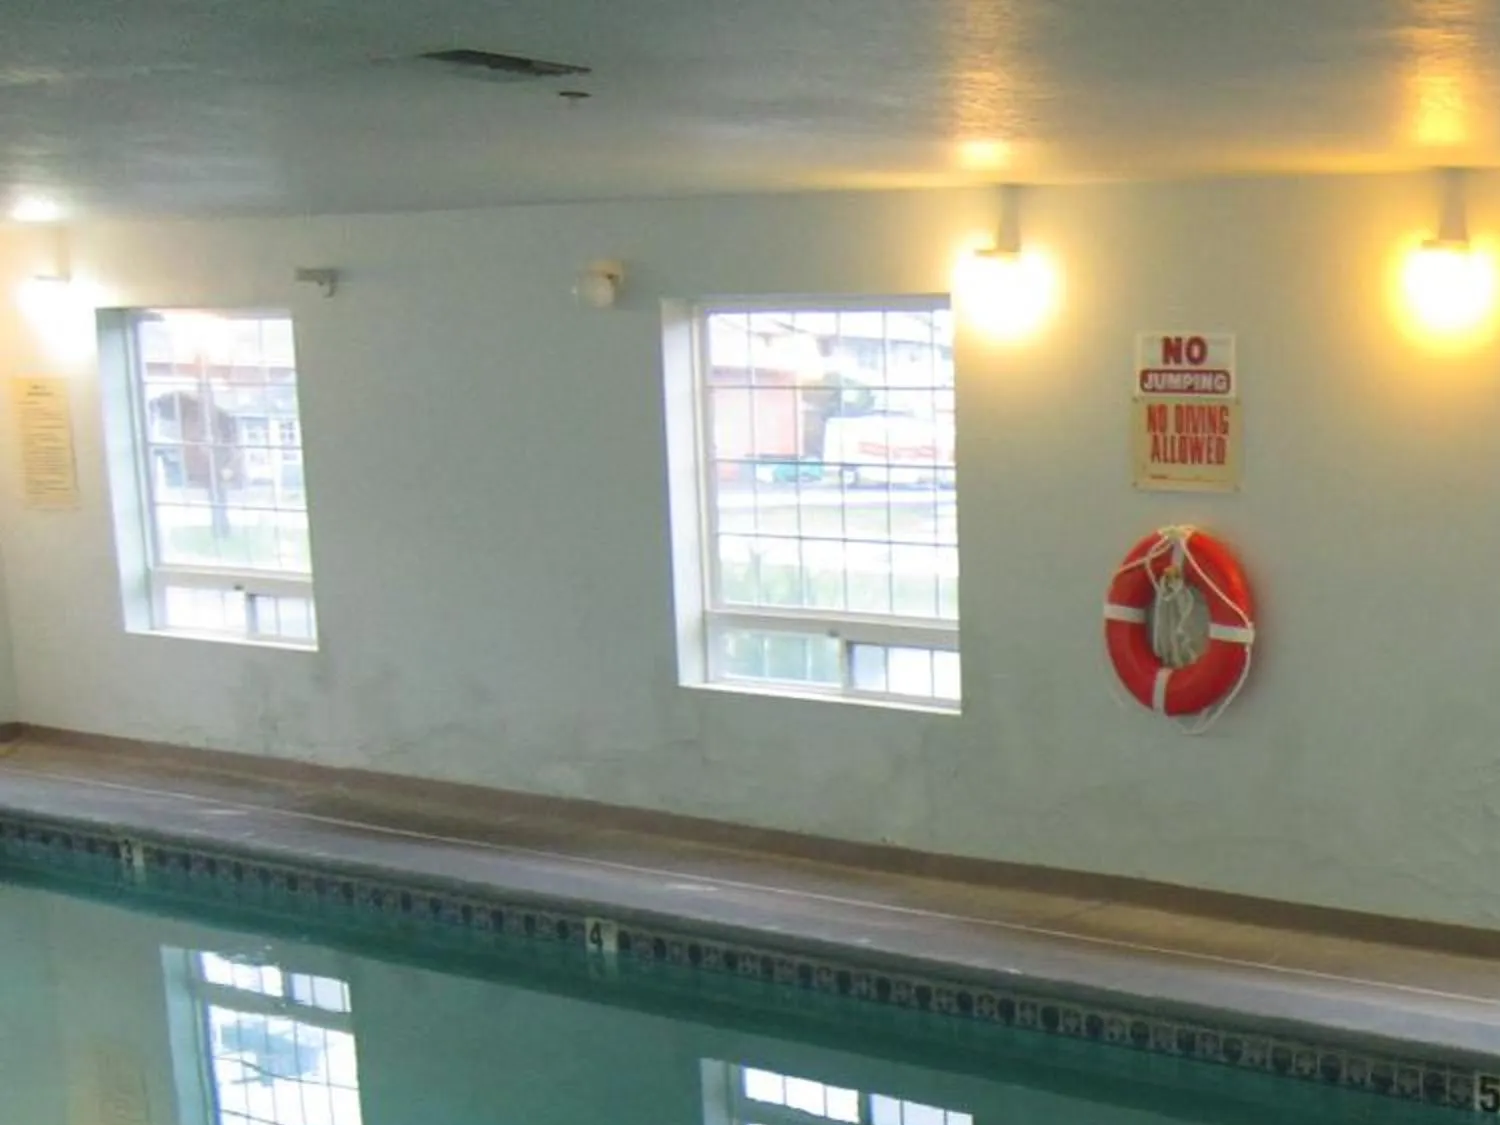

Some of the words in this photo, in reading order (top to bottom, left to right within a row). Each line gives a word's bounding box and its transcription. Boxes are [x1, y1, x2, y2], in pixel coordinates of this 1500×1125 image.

[1162, 336, 1207, 365] NO
[1144, 373, 1226, 390] JUMPING
[1147, 403, 1167, 432] NO
[1174, 405, 1229, 434] DIVING
[1151, 435, 1226, 464] ALLOWED
[590, 920, 603, 949] 4
[1480, 1075, 1500, 1113] 5
